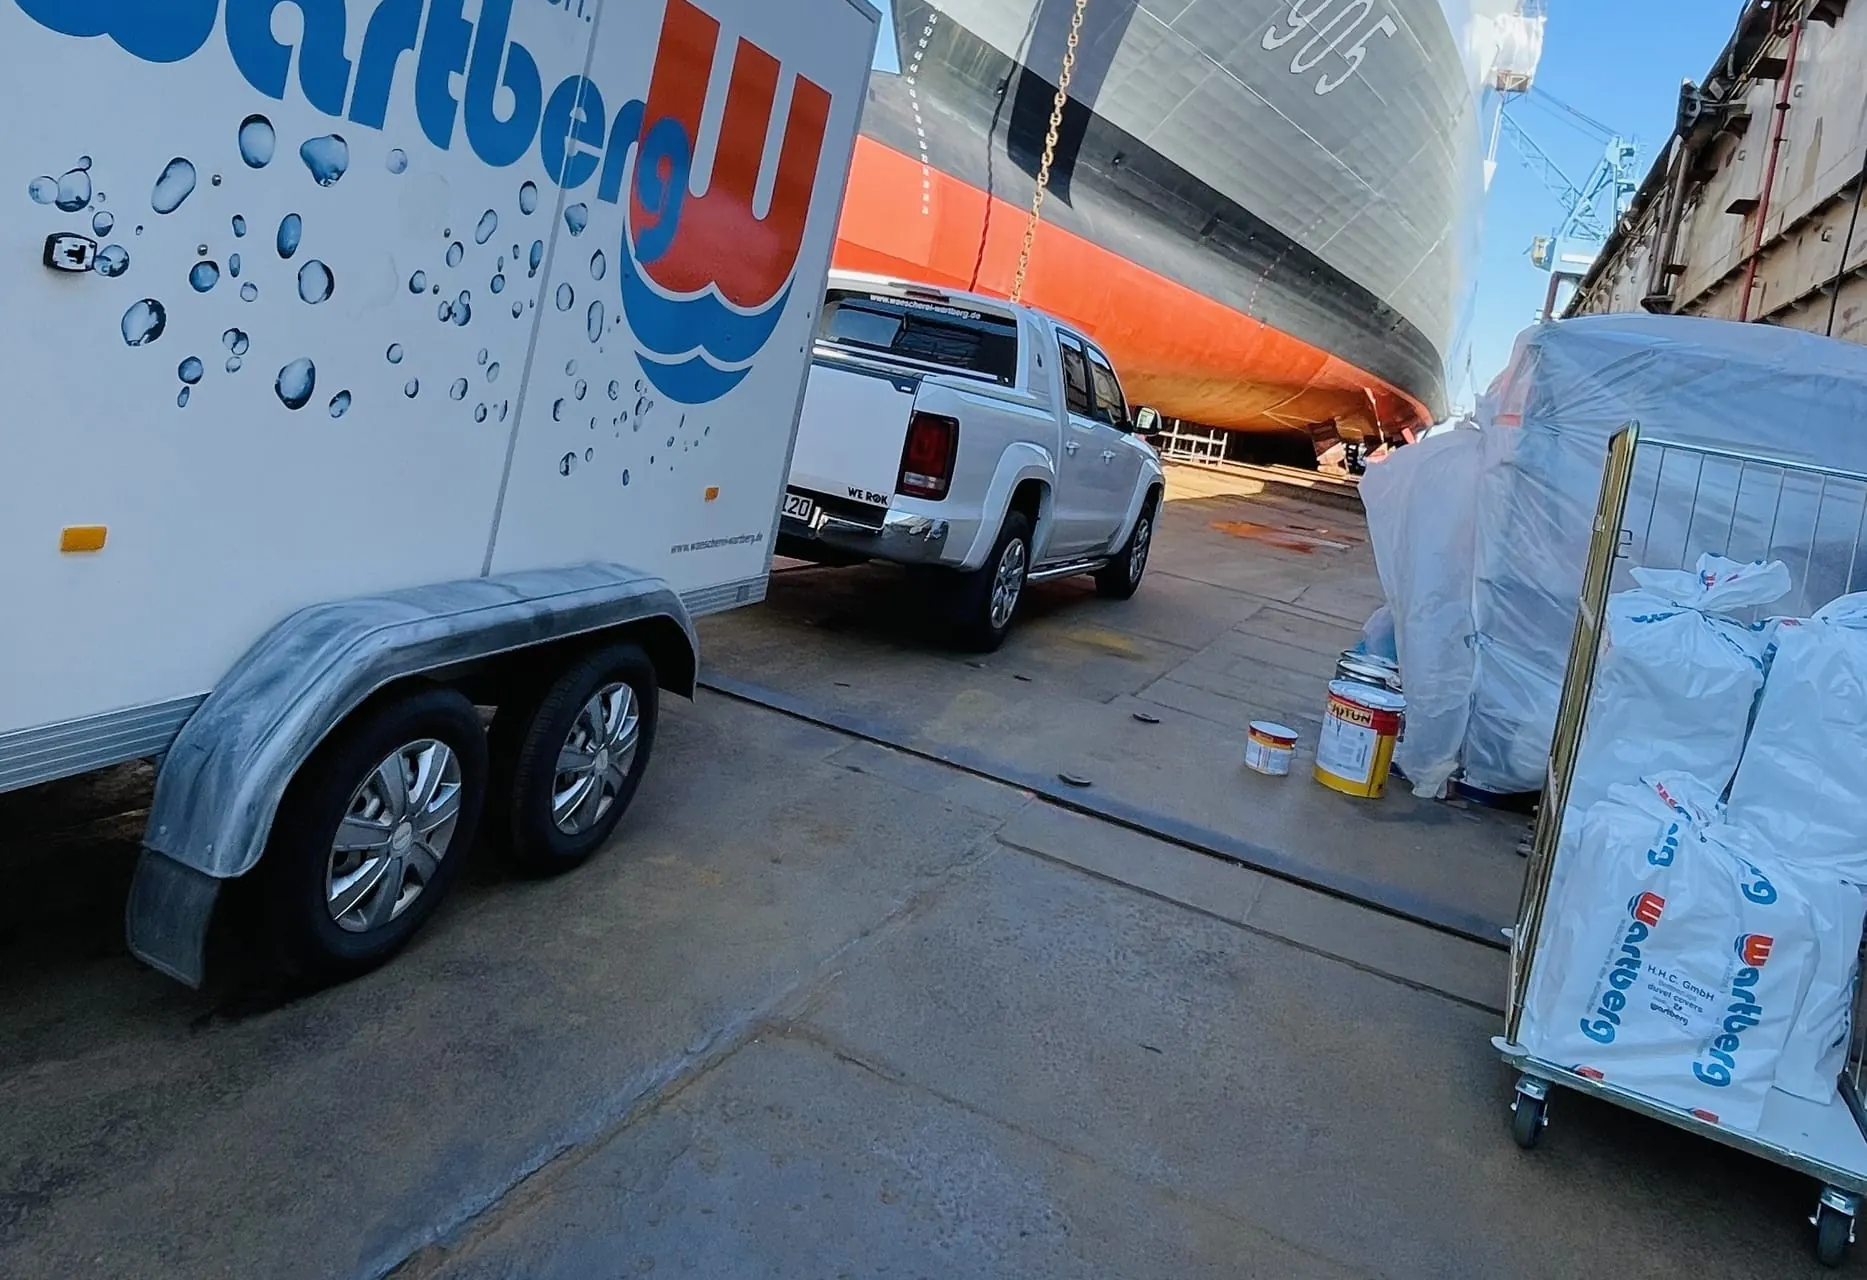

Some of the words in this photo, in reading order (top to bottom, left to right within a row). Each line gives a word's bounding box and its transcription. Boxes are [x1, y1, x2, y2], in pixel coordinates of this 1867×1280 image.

[847, 486, 864, 500] WE
[1682, 980, 1715, 1001] GmbH
[1673, 995, 1704, 1013] covers
